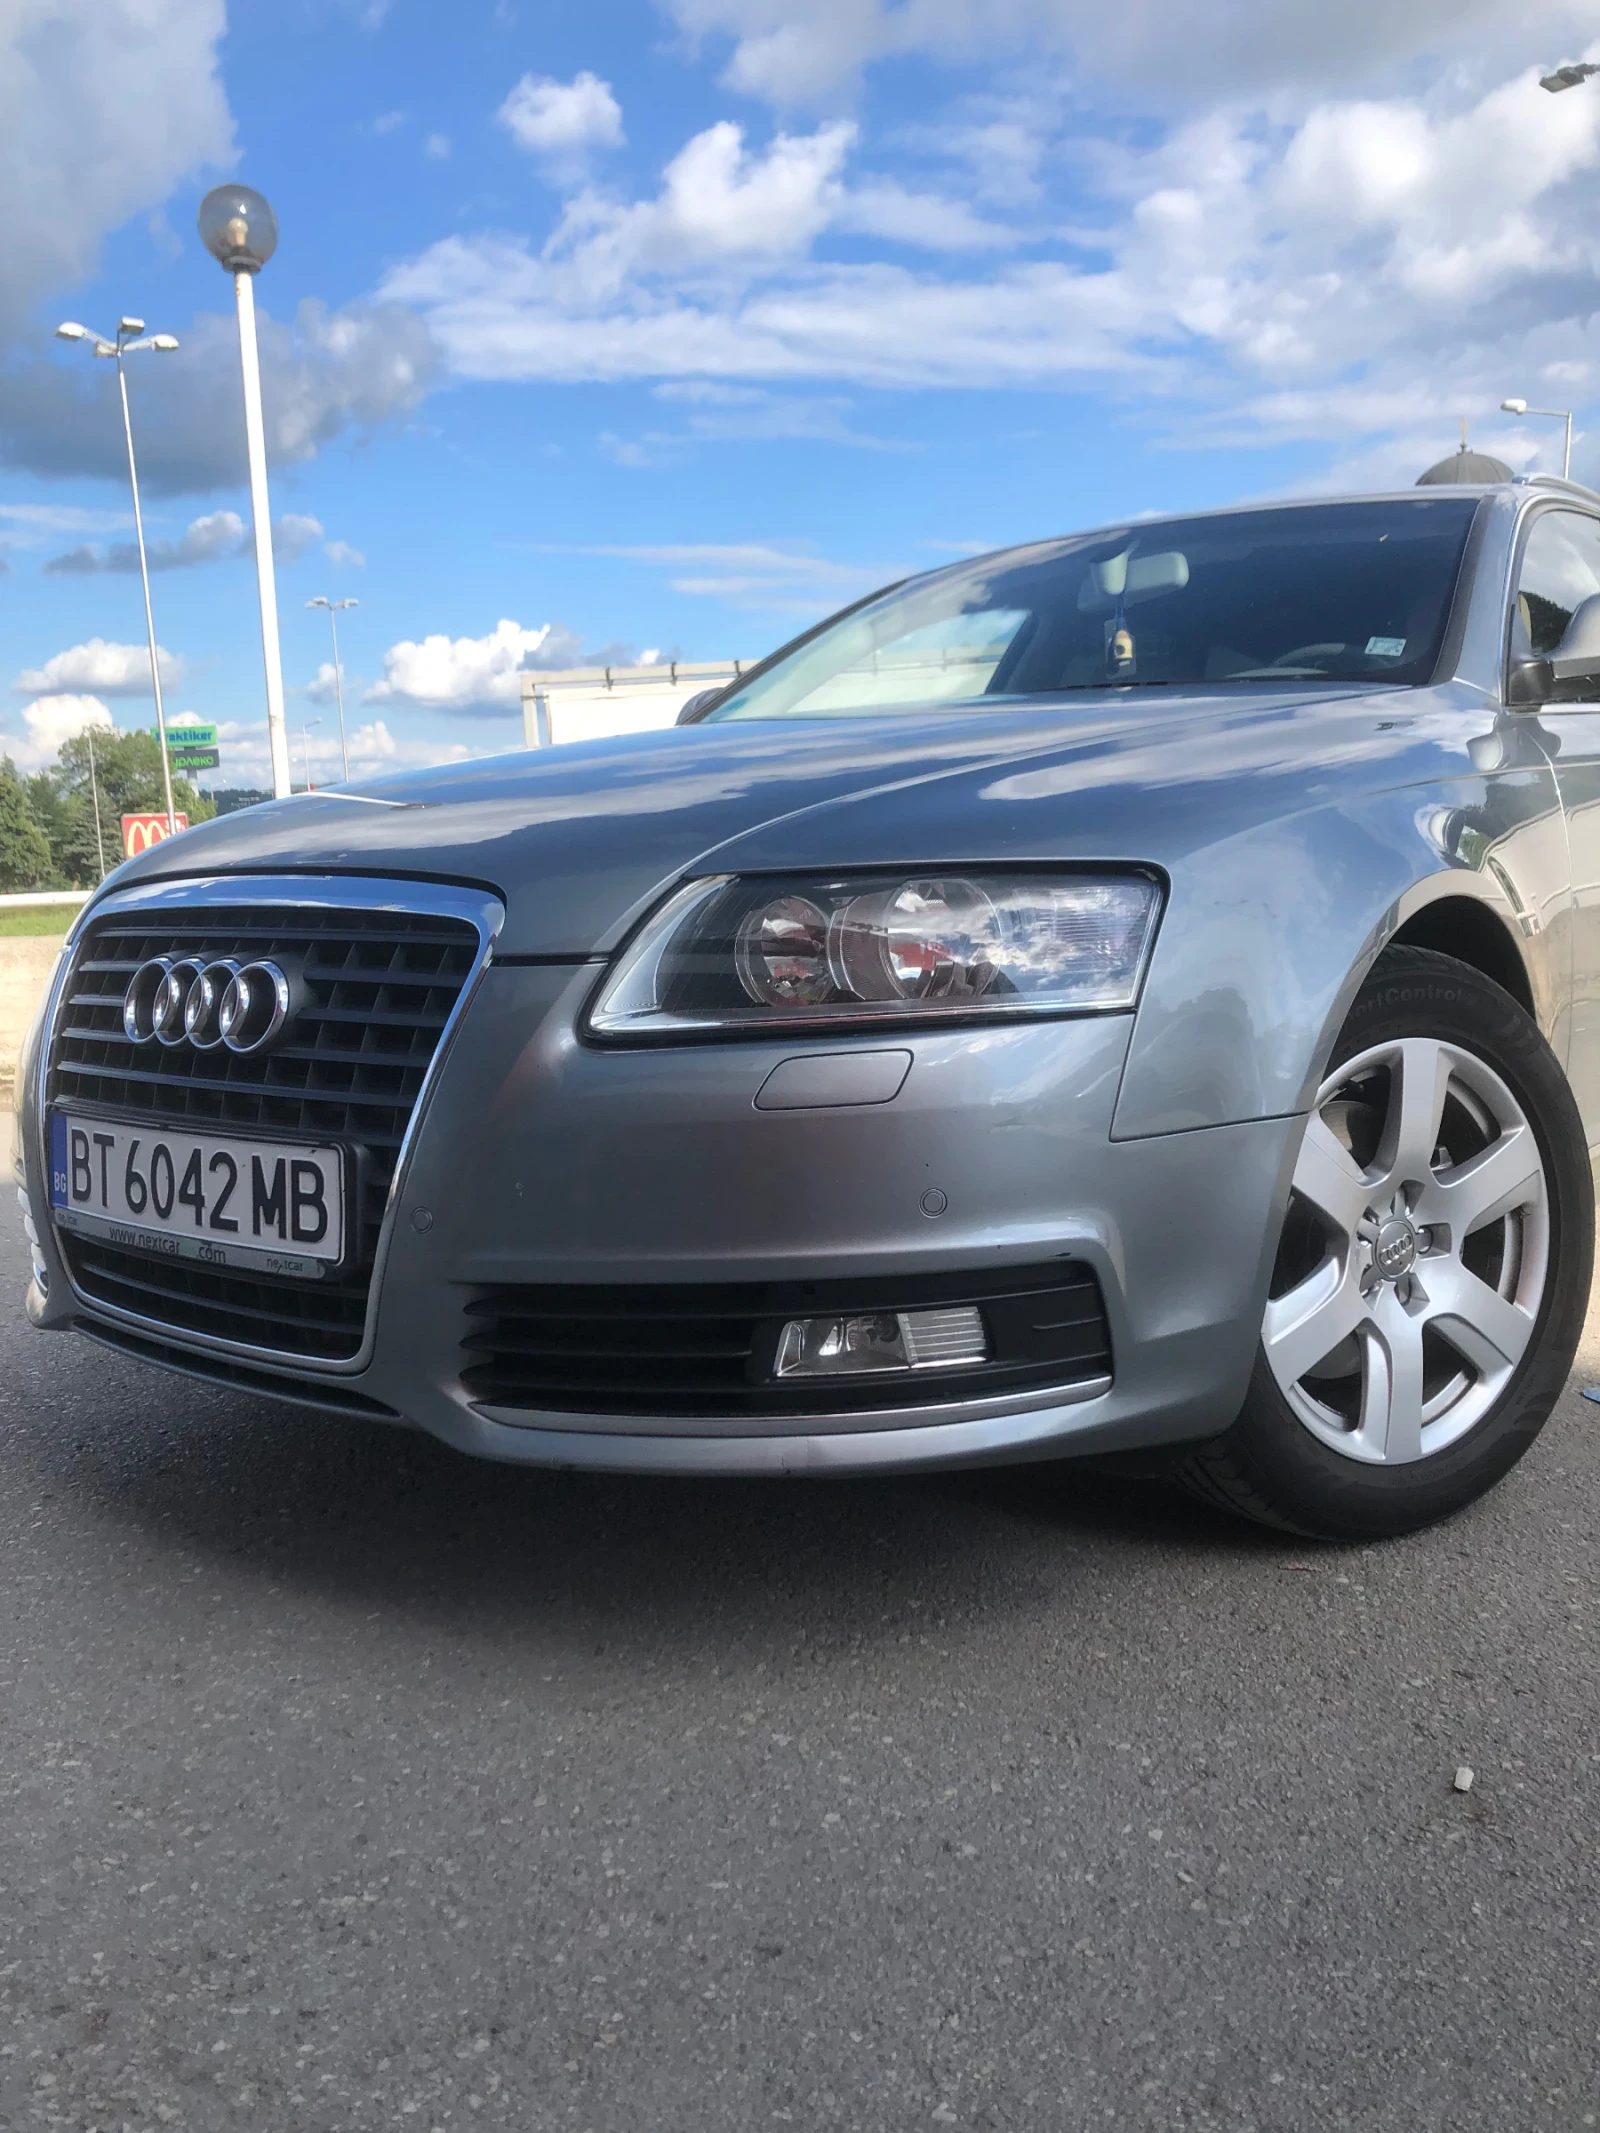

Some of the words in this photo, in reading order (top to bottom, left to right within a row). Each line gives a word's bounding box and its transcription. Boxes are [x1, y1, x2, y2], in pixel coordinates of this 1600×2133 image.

[156, 729, 212, 742] aktiker
[54, 1170, 67, 1193] BG
[71, 1128, 116, 1209] BT
[124, 1140, 240, 1232] 6042
[252, 1155, 328, 1243] MB
